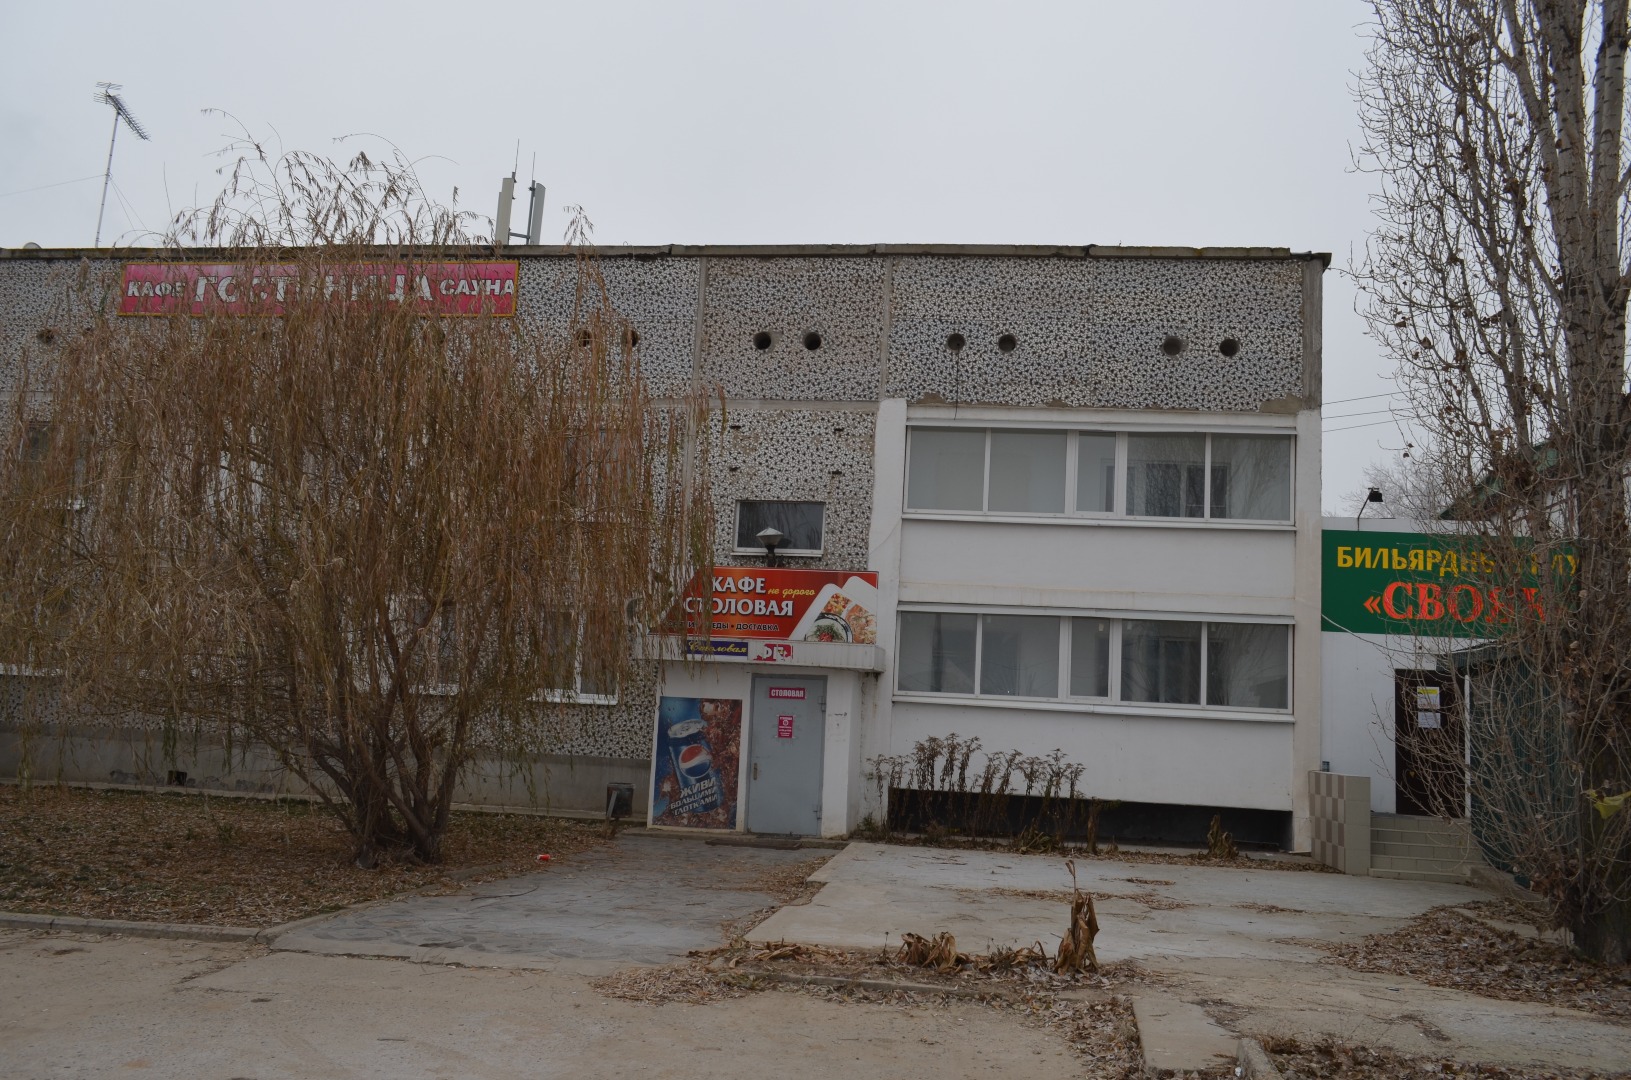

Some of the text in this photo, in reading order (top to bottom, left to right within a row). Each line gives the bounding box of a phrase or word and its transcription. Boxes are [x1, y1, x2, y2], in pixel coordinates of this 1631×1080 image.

[195, 274, 432, 303] ГОСТНИЦА
[440, 279, 515, 296] САУНА
[712, 576, 766, 594] КАФЕ
[782, 588, 816, 598] дорого
[685, 596, 794, 617] СТОЛОВАЯ
[735, 623, 779, 631] ДОСТАВКА
[670, 786, 718, 810] БОЛЬШИМИ
[679, 776, 716, 799] ЖИВИ
[674, 794, 718, 817] ГЛОТКАМИ
